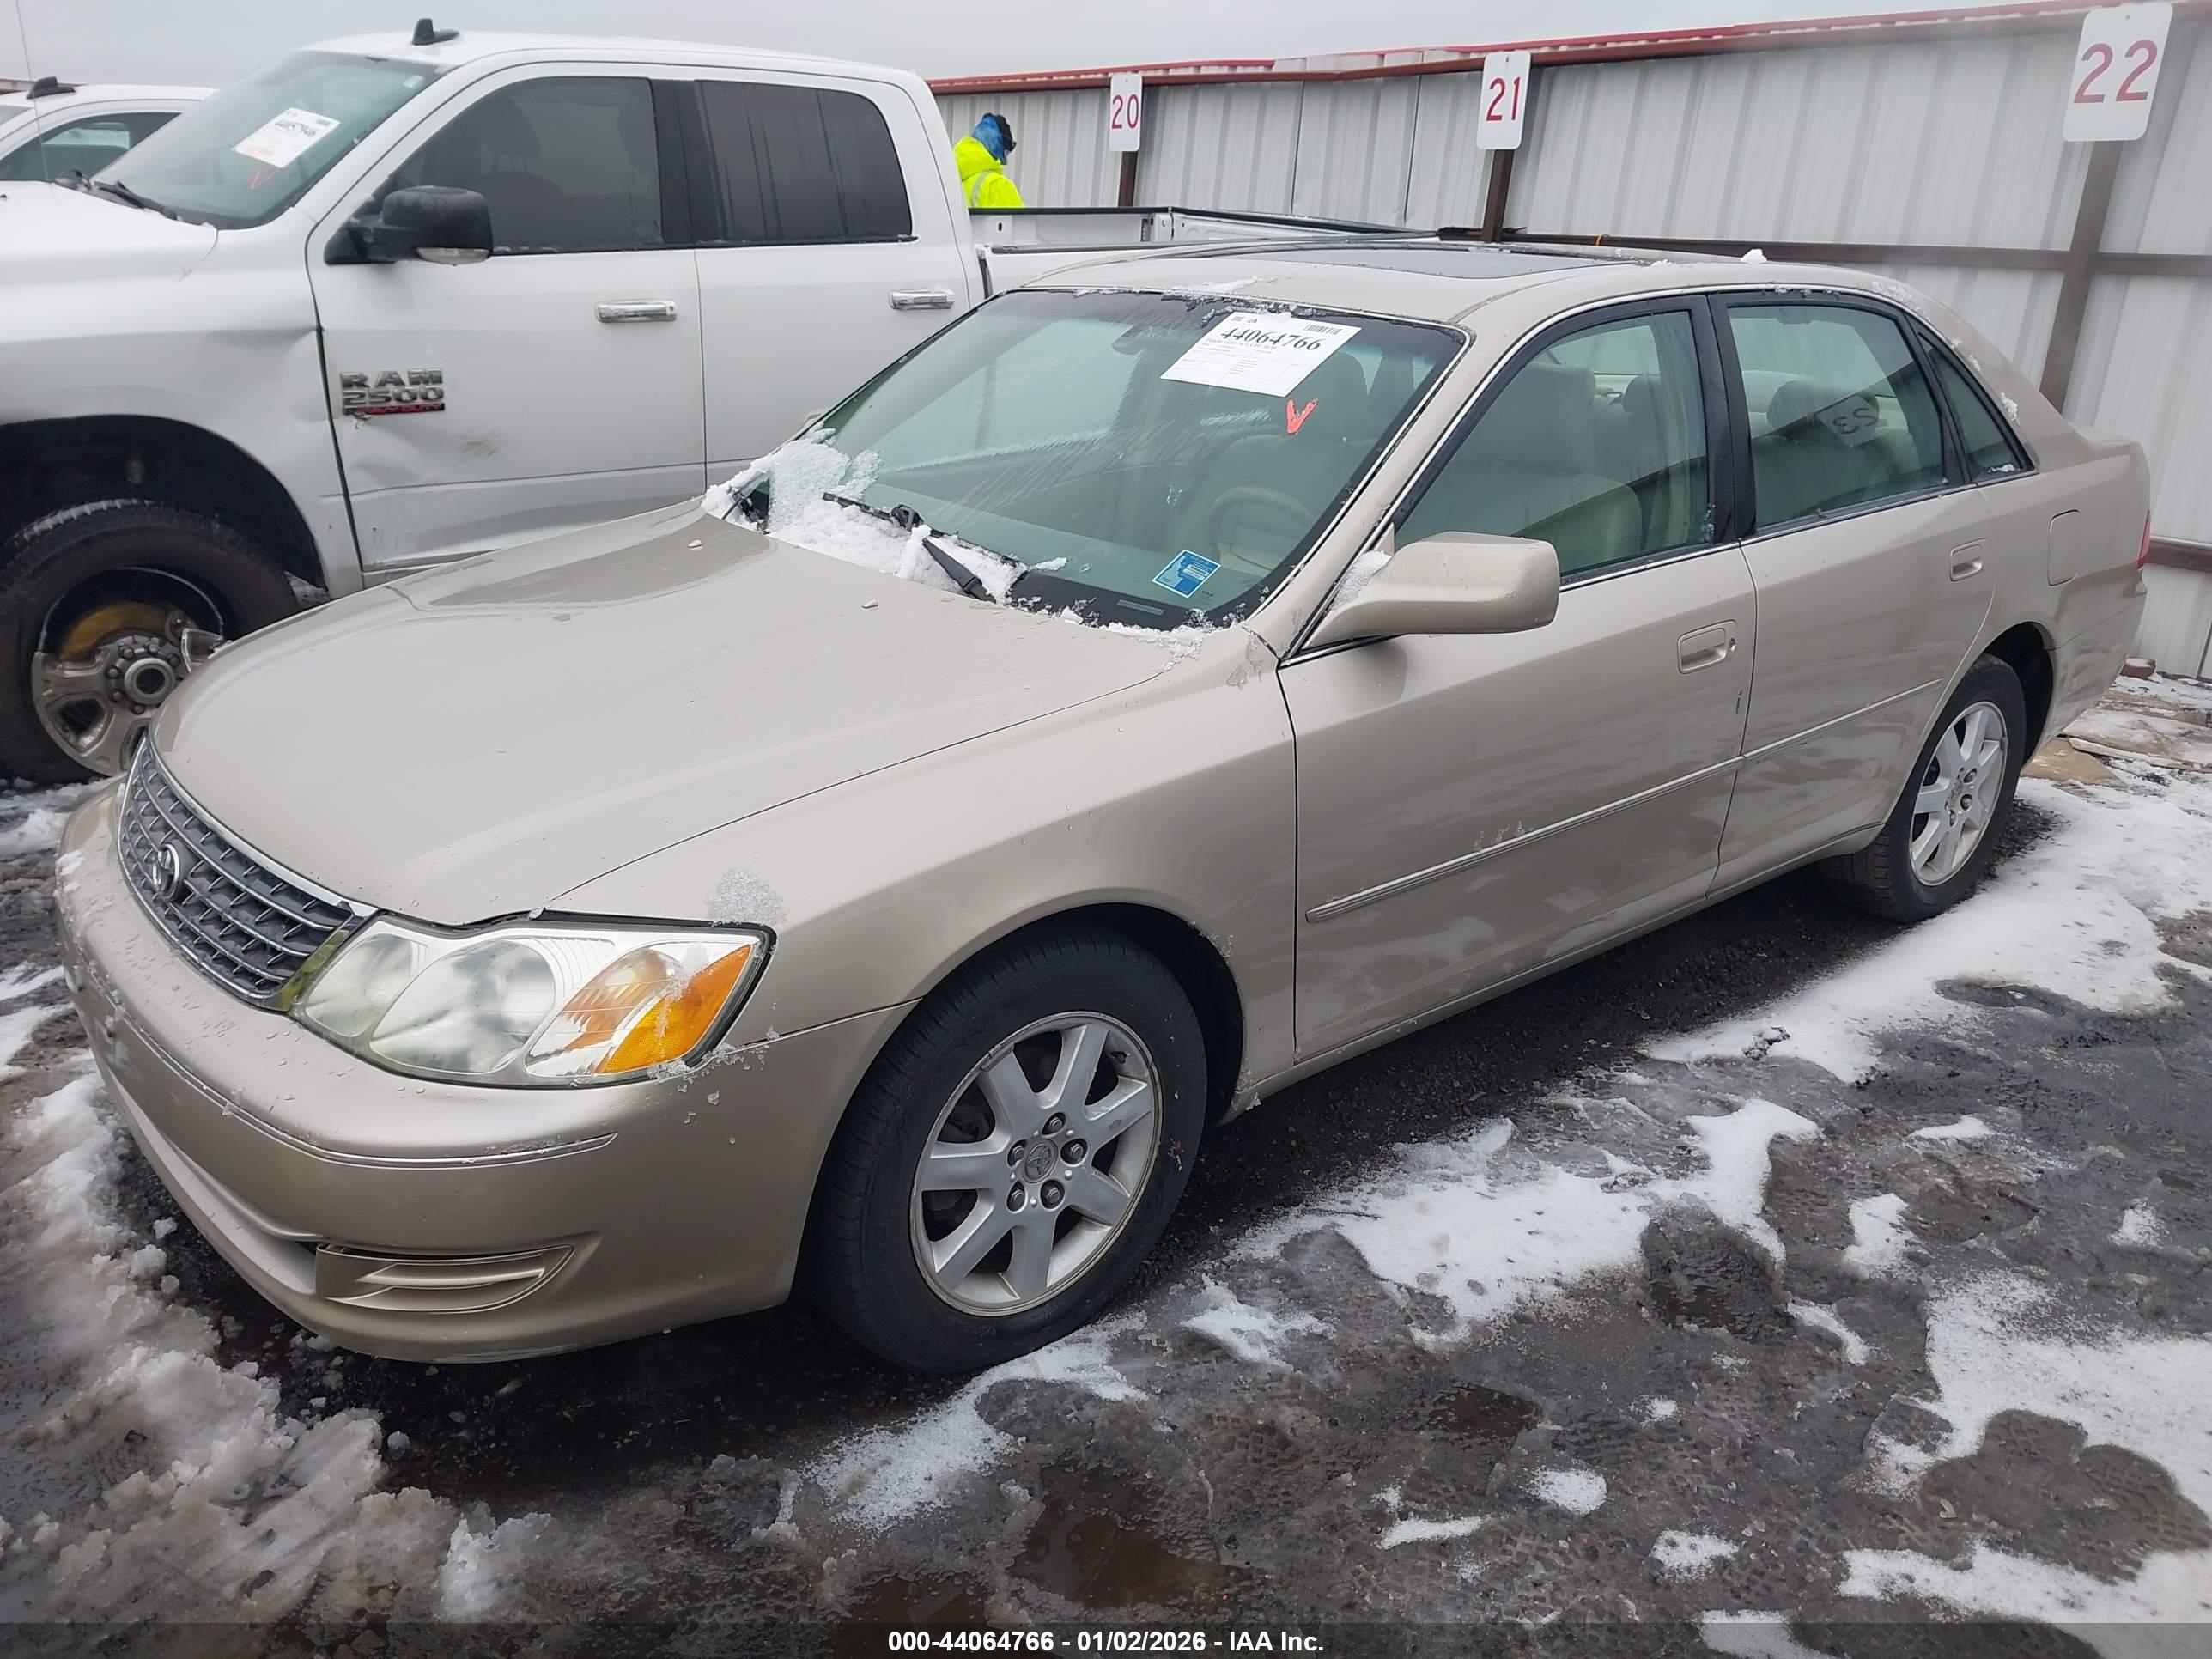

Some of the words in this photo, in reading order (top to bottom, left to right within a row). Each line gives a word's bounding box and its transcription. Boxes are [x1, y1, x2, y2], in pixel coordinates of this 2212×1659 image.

[2074, 39, 2158, 104] 22
[1111, 94, 1139, 129] 20
[1486, 76, 1521, 122] 21
[1220, 326, 1328, 352] 44064766
[340, 368, 443, 388] RAM
[343, 386, 444, 404] 2500
